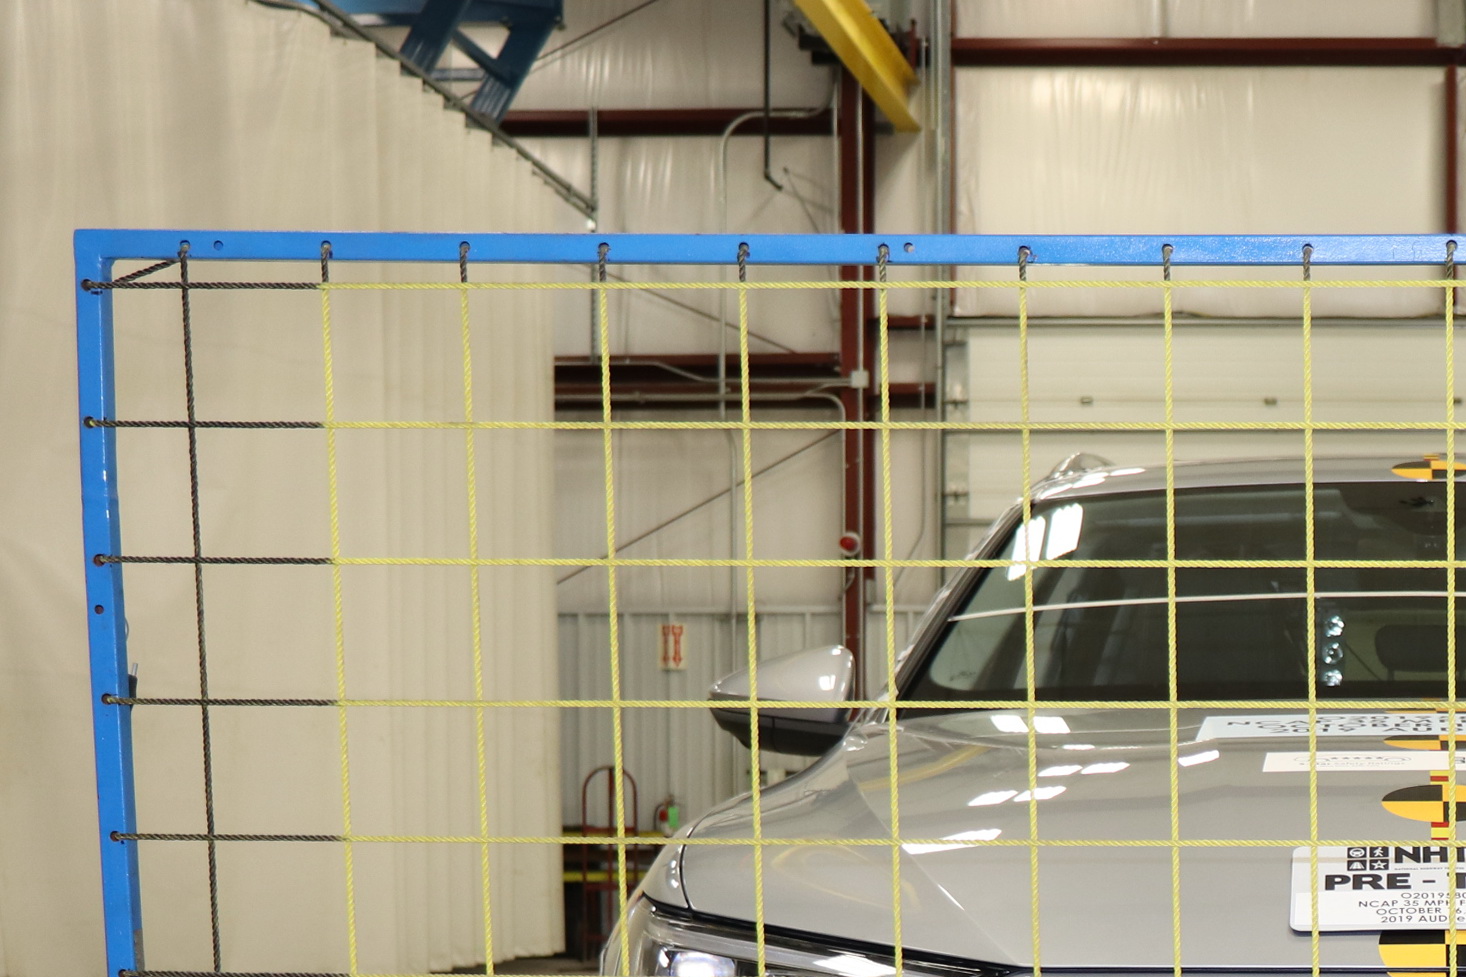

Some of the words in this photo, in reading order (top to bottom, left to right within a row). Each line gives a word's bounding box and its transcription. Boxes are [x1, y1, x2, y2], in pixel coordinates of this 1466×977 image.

[1325, 873, 1411, 890] PRE
[1358, 900, 1399, 908] NCAP
[1376, 907, 1442, 915] OCTOBER
[1381, 915, 1413, 923] 2019
[1418, 914, 1451, 923] AUD
